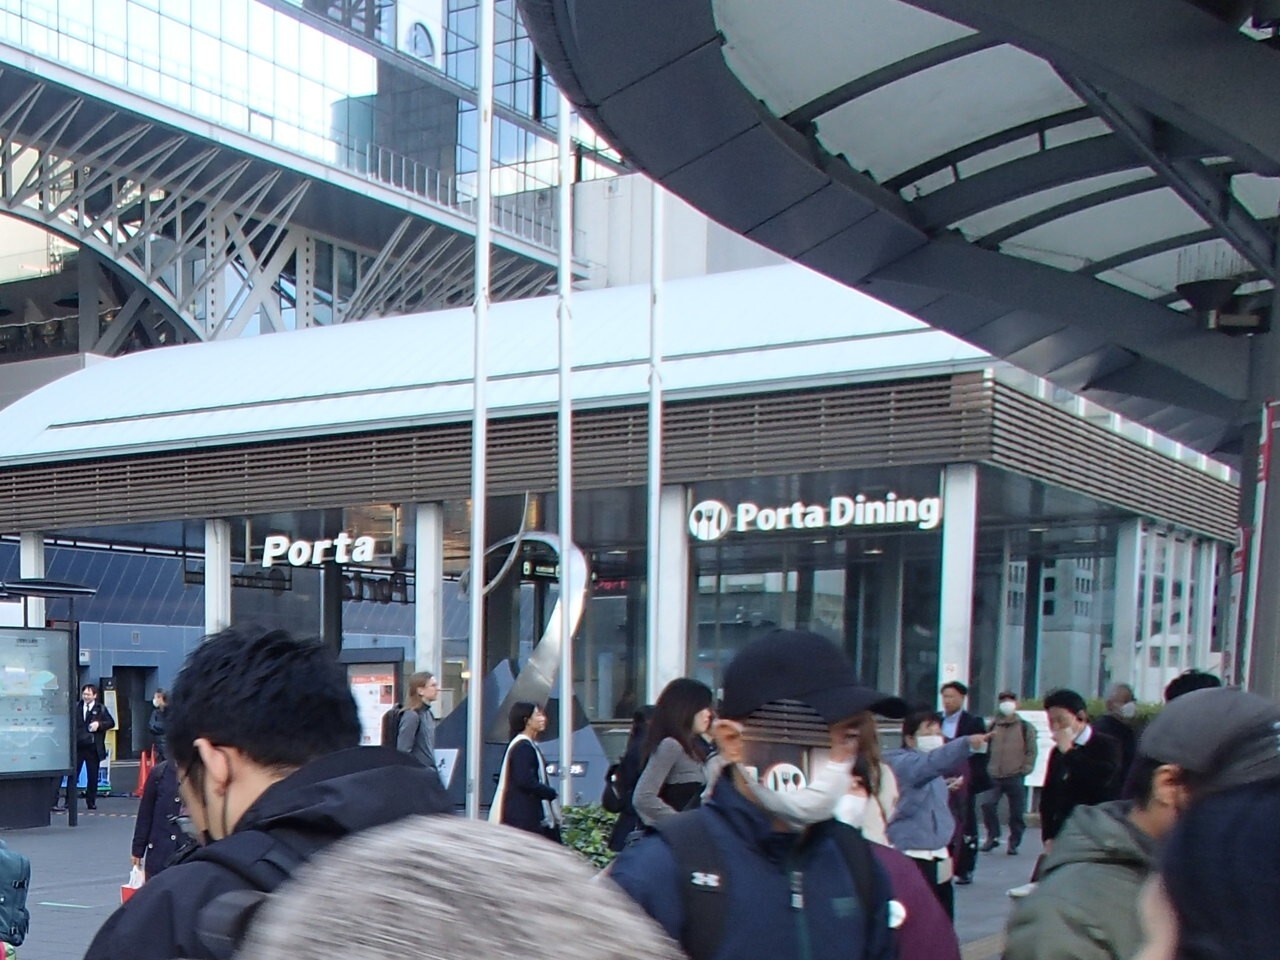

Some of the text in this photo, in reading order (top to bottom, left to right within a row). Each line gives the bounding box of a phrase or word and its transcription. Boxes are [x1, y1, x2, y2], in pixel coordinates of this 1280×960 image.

[736, 491, 940, 532] Porta Dining
[261, 532, 376, 568] Porta
